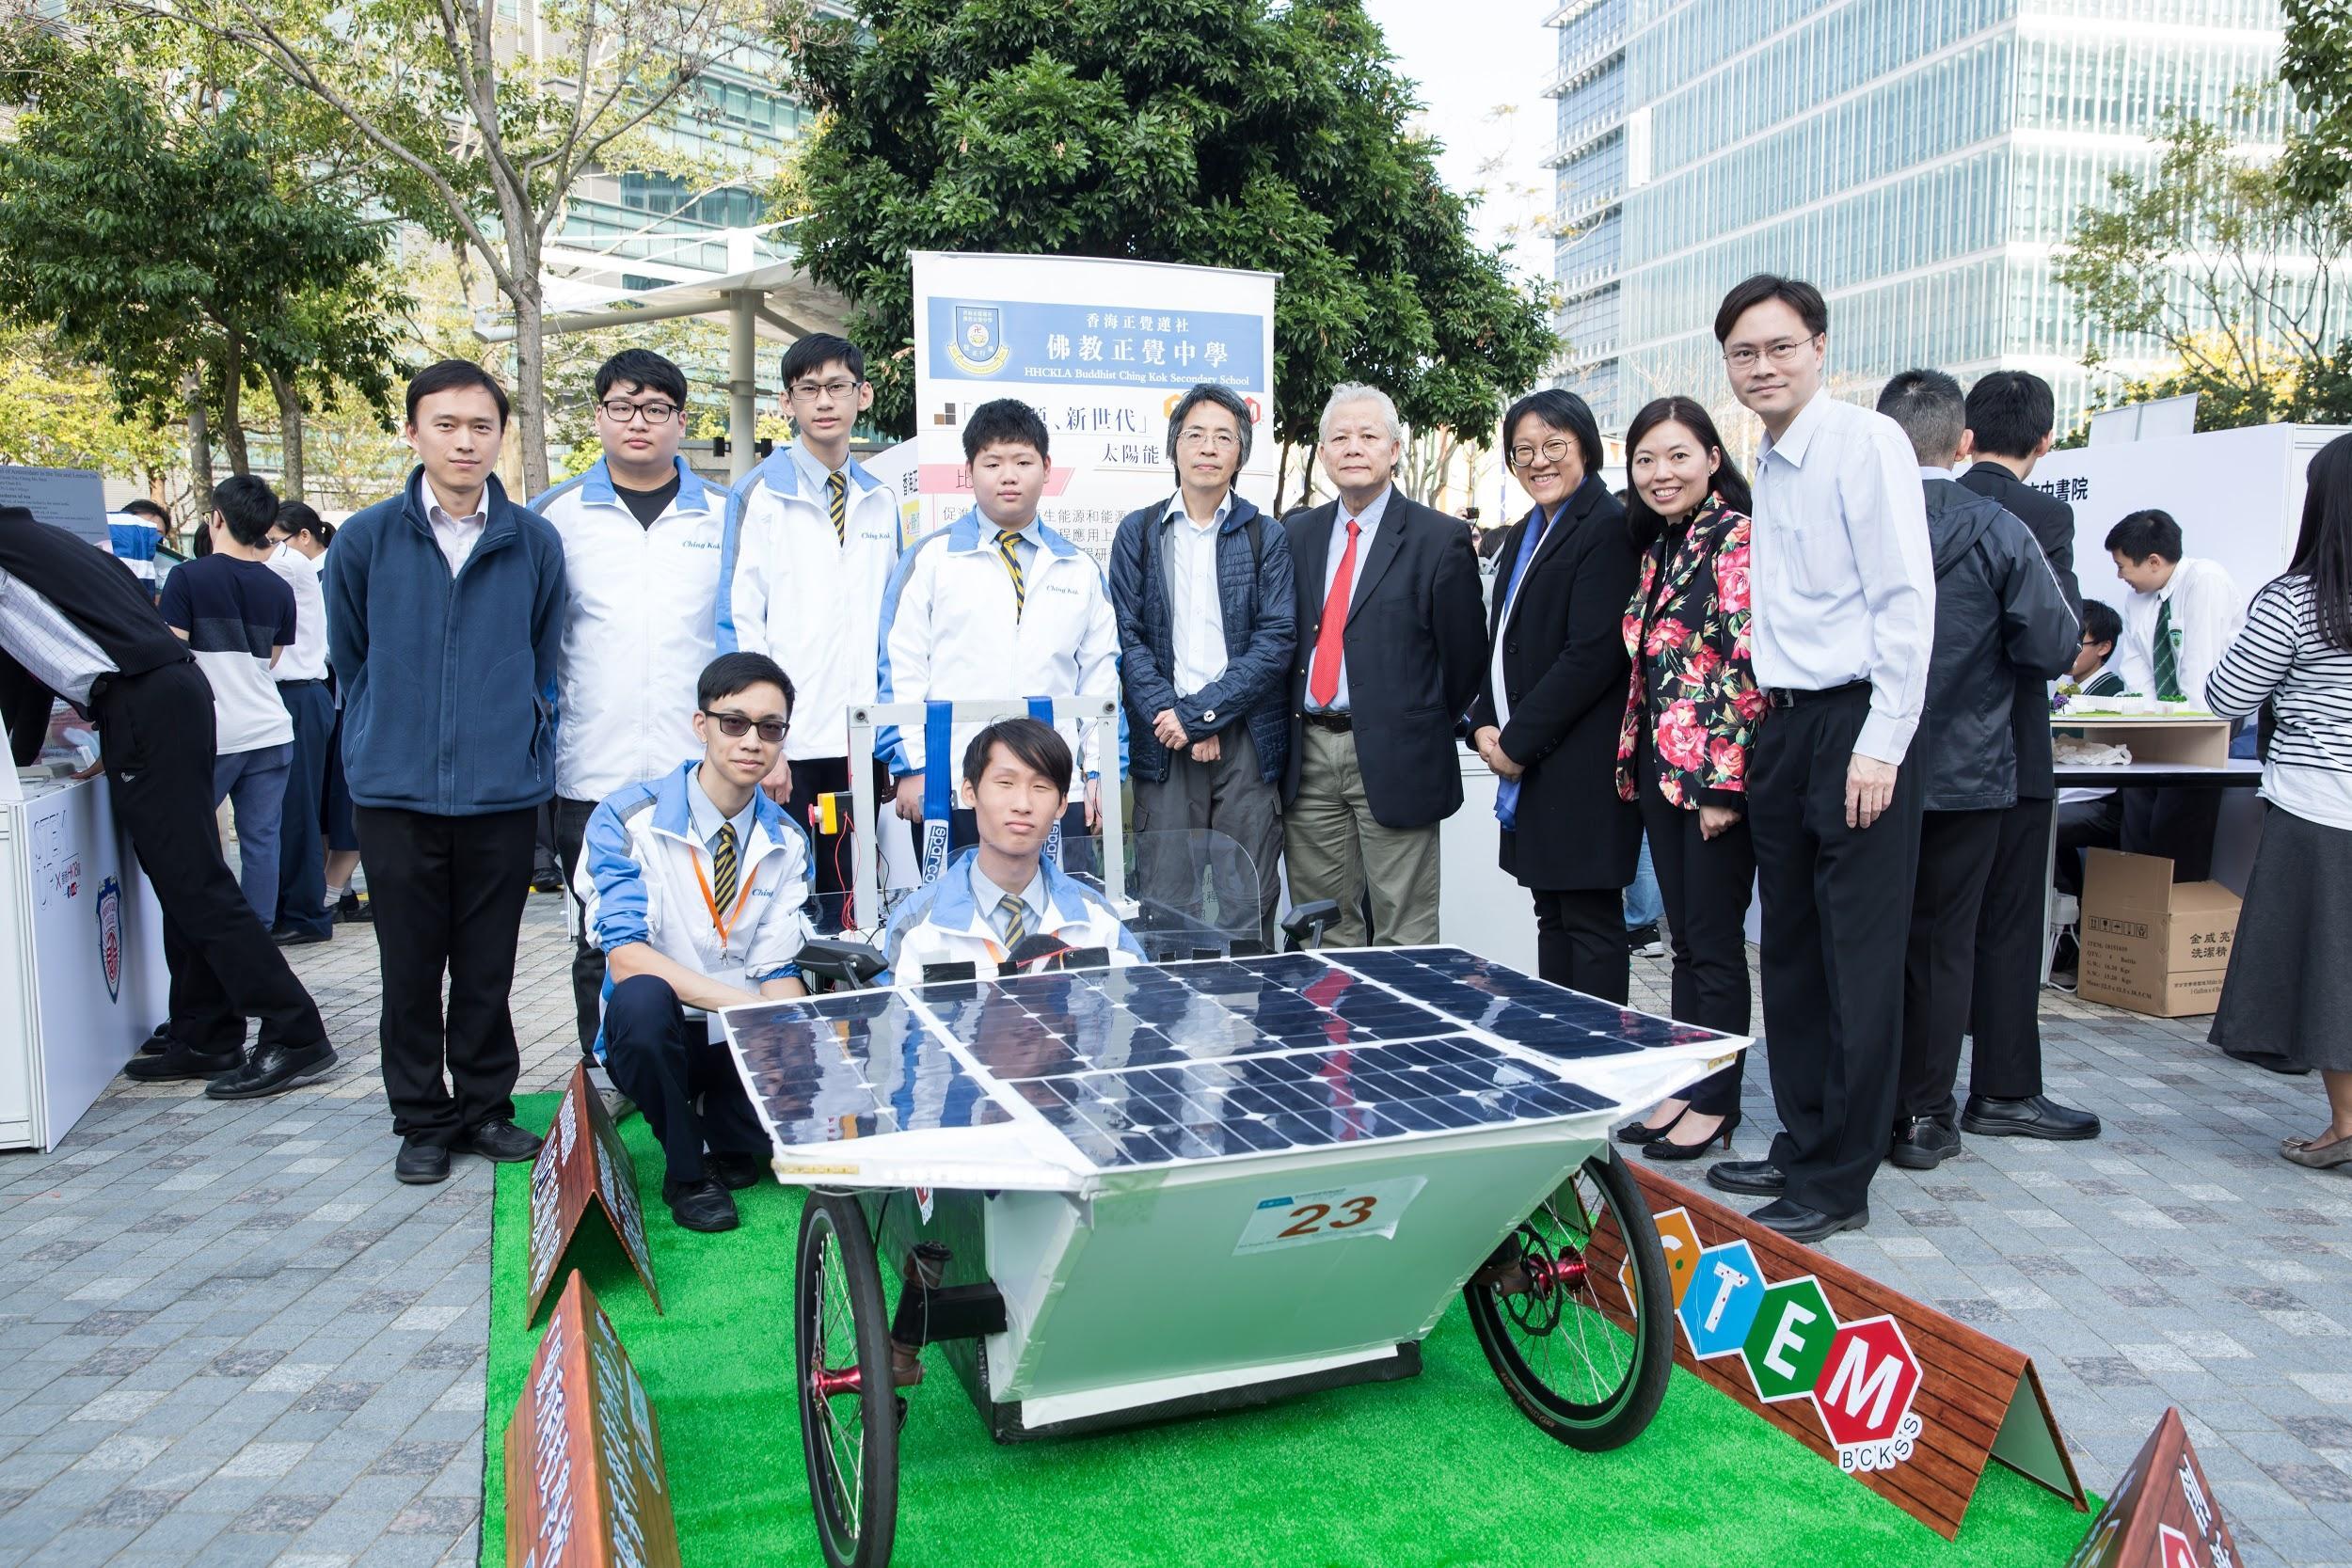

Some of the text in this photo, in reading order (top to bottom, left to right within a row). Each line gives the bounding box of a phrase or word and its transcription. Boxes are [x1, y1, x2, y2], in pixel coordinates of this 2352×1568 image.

[1087, 312, 1189, 333] 香海正覺蓮社
[1046, 333, 1228, 368] 佛教正覺中學
[1025, 367, 1249, 386] HHCKLA Buddhist Ching Kok Secondary School
[1102, 443, 1173, 466] 太陽能
[2031, 477, 2089, 501] 中書院
[1038, 508, 1128, 524] 生能源和能源
[682, 540, 706, 549] Ching
[925, 826, 947, 883] sparco
[752, 888, 773, 898] Ching
[1277, 1196, 1377, 1238] 23
[1661, 1234, 1904, 1430] TEM
[1842, 1417, 1919, 1468] BCKSS
